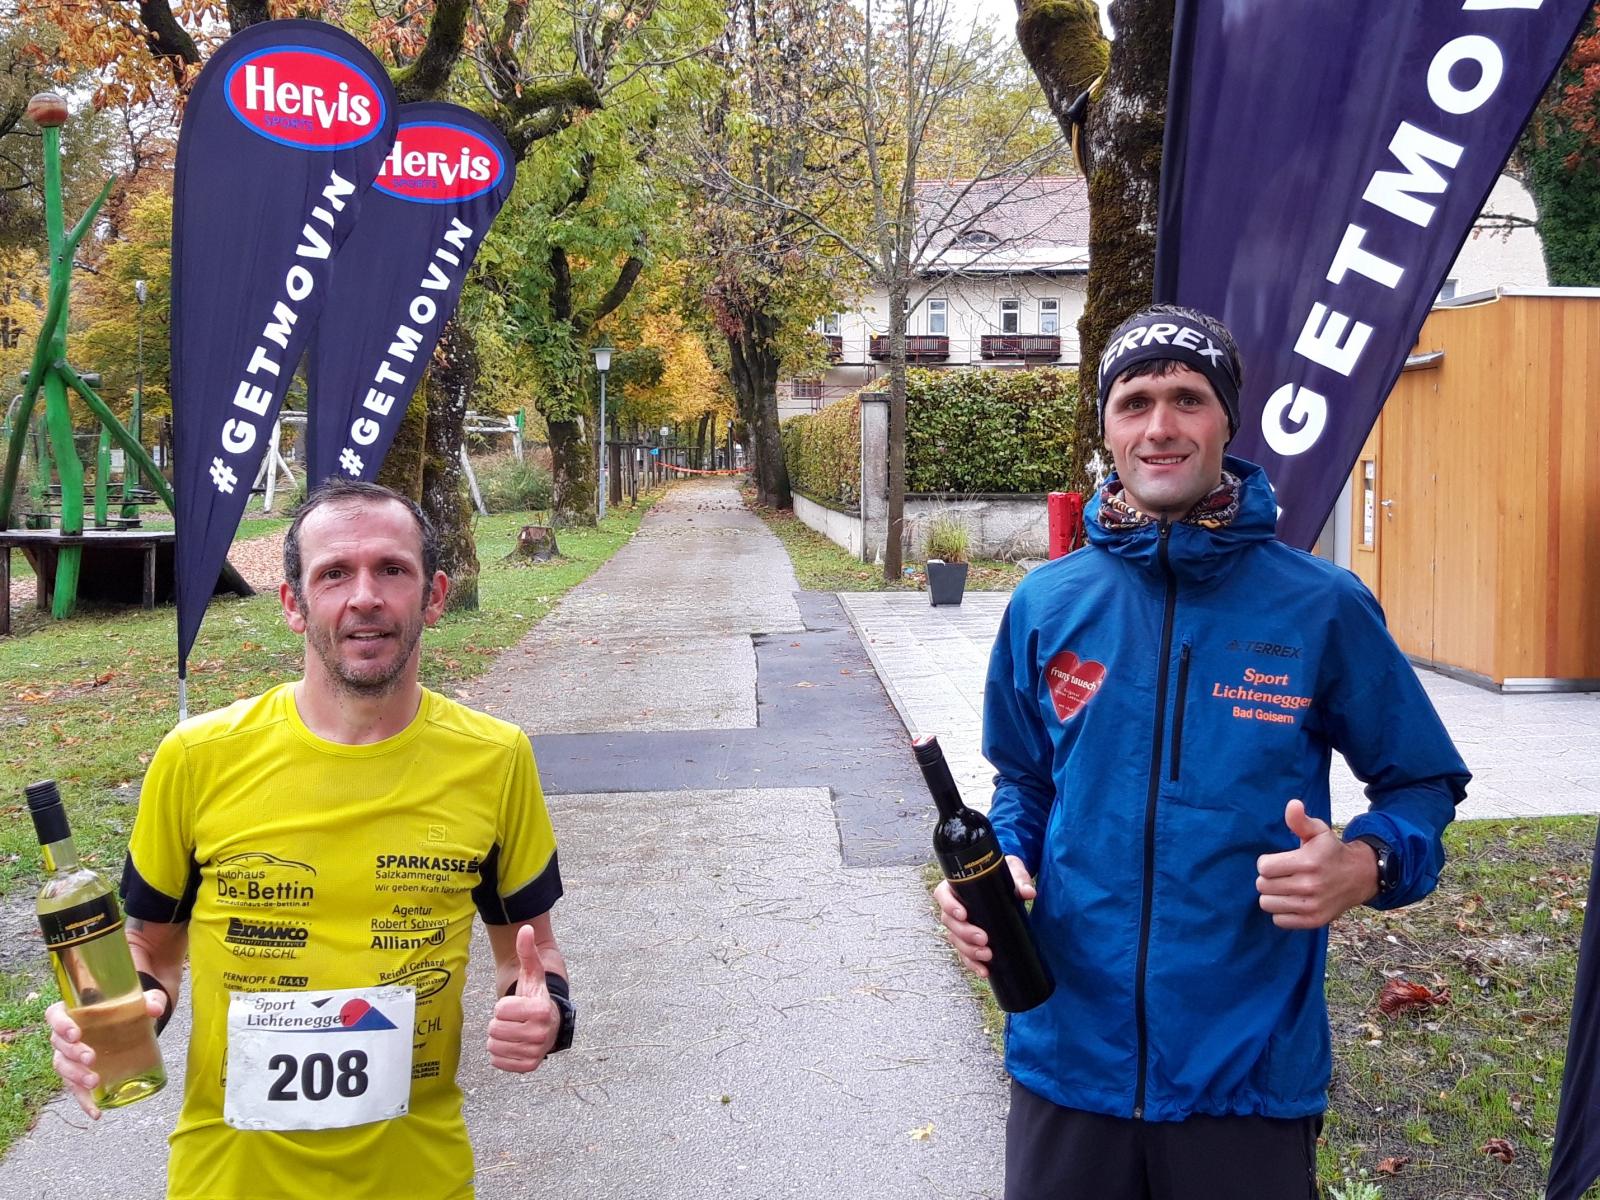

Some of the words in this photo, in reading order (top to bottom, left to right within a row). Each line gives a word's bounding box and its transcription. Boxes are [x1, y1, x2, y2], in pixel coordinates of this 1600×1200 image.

[244, 64, 371, 128] Hervis
[264, 115, 313, 131] SPORTS
[378, 141, 491, 186] Hervis
[393, 178, 438, 189] SPORTS
[208, 168, 355, 494] #GETMOVIN
[339, 217, 473, 477] #GETMOVIN
[1100, 323, 1223, 377] ERREX
[1246, 641, 1302, 659] TERREX
[1243, 668, 1289, 685] Sport
[1212, 683, 1312, 709] Lichtenegger
[1233, 706, 1253, 718] Bad
[376, 855, 465, 872] SPARKASSE
[217, 870, 265, 879] Autohaus
[375, 870, 450, 882] Salzkammergut
[217, 878, 314, 899] De-Bettin
[392, 884, 418, 892] geben
[392, 904, 432, 917] Agentur
[371, 918, 407, 929] Robert
[232, 945, 256, 957] BAD
[259, 948, 297, 960] ISCHL
[410, 958, 445, 971] Gerhard
[223, 972, 267, 984] PERNKOPF
[280, 976, 307, 986] HAAS
[254, 998, 296, 1013] Sport
[247, 1013, 350, 1029] Lichtenegger
[267, 1049, 369, 1101] 208
